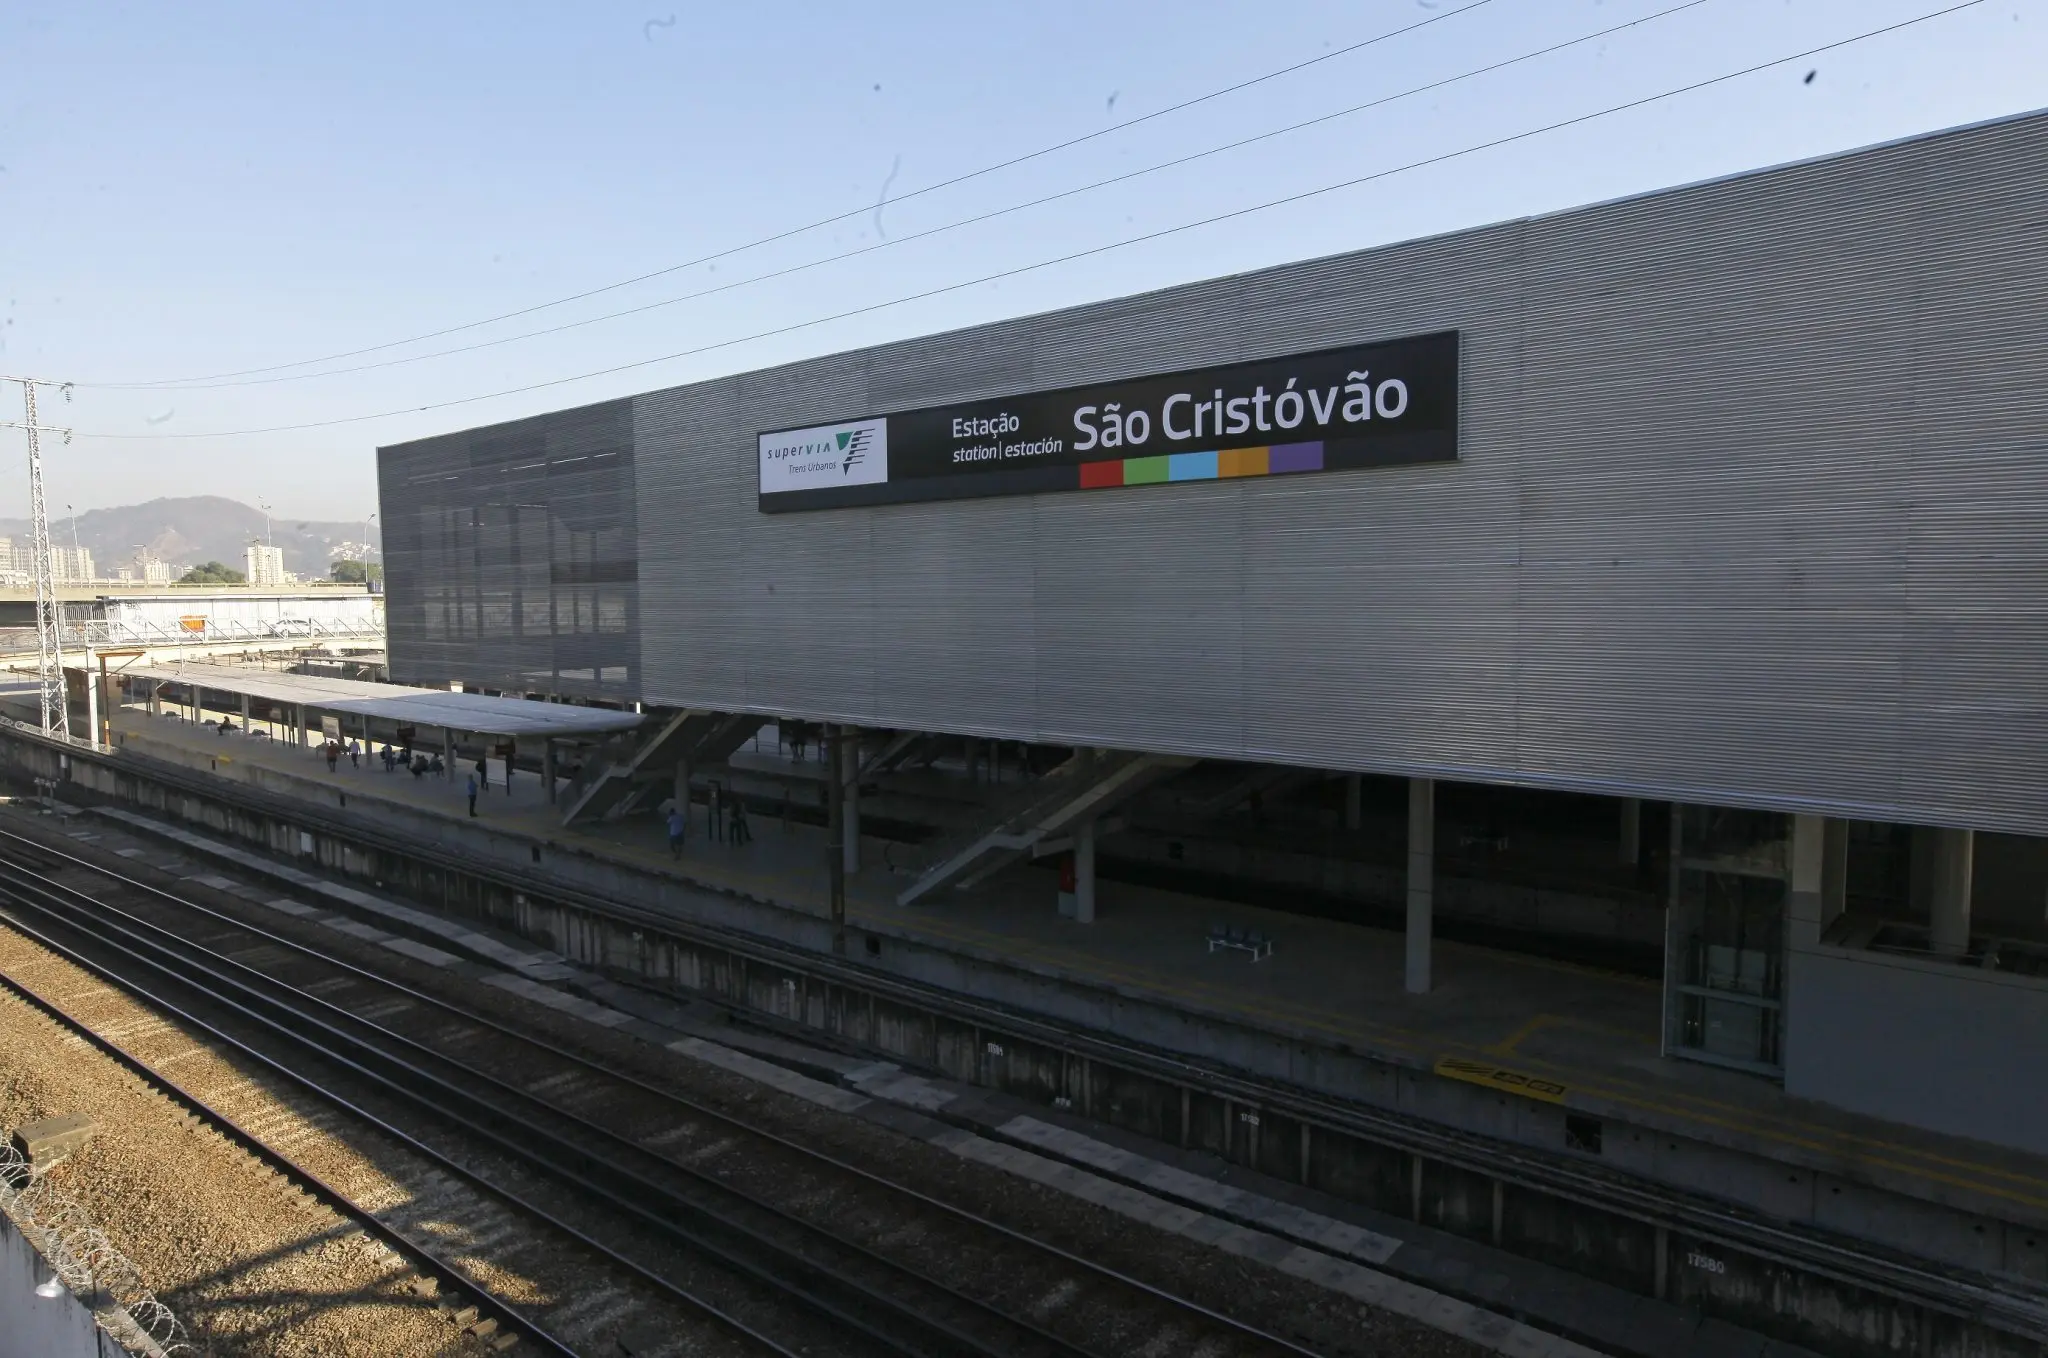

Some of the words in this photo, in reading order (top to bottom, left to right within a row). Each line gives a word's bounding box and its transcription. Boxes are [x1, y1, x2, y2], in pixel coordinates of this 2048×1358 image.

[1073, 402, 1150, 451] São
[1162, 369, 1409, 441] Cristóvão
[953, 412, 1020, 439] Estação
[788, 464, 806, 474] Trens
[808, 461, 837, 473] Urbanos
